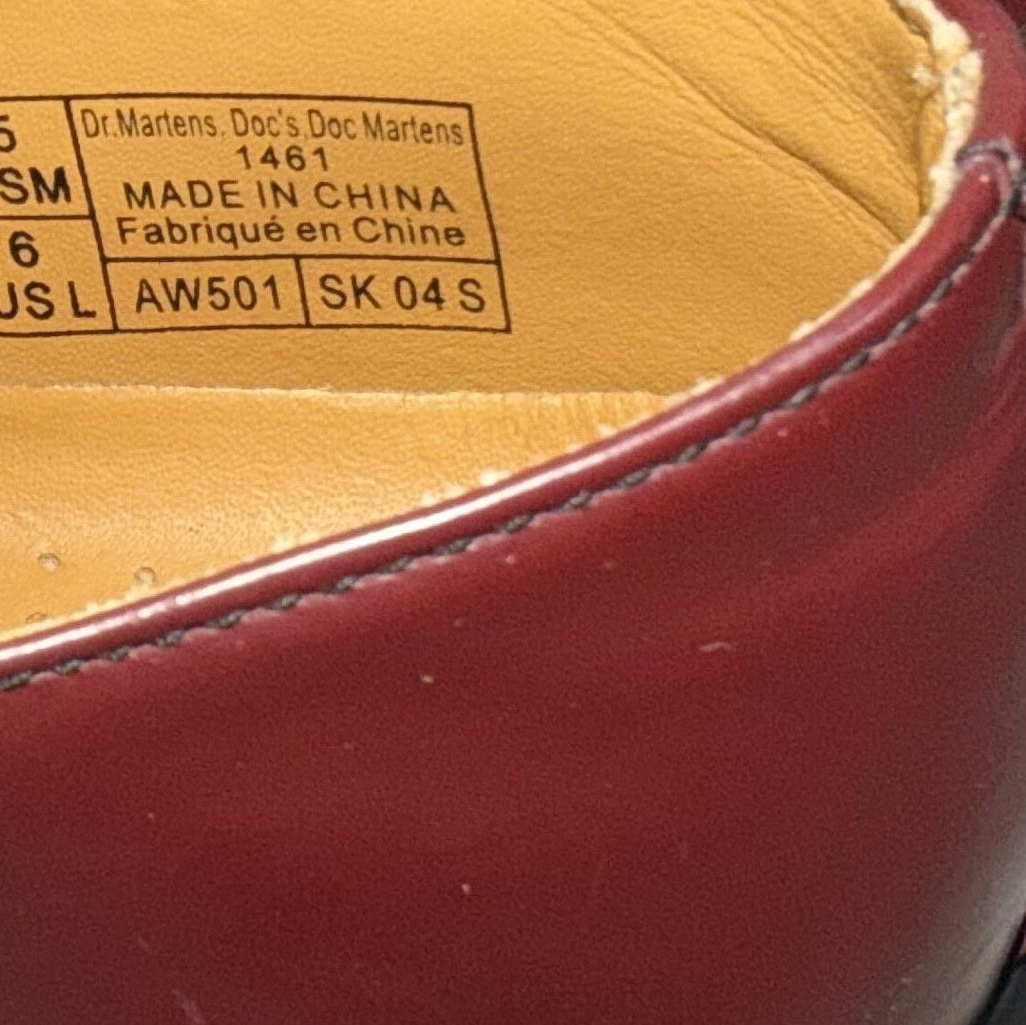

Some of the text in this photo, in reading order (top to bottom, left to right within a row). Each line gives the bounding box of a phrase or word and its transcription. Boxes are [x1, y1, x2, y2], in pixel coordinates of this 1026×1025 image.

[307, 108, 357, 140] Doc
[362, 111, 464, 146] Martens
[236, 145, 328, 172] 1461
[123, 180, 456, 213] MADE IN CHINA
[9, 231, 39, 268] 6
[117, 214, 466, 249] Fabriqué en Chine
[135, 274, 282, 313] AW501
[319, 274, 485, 313] SK 04 S
